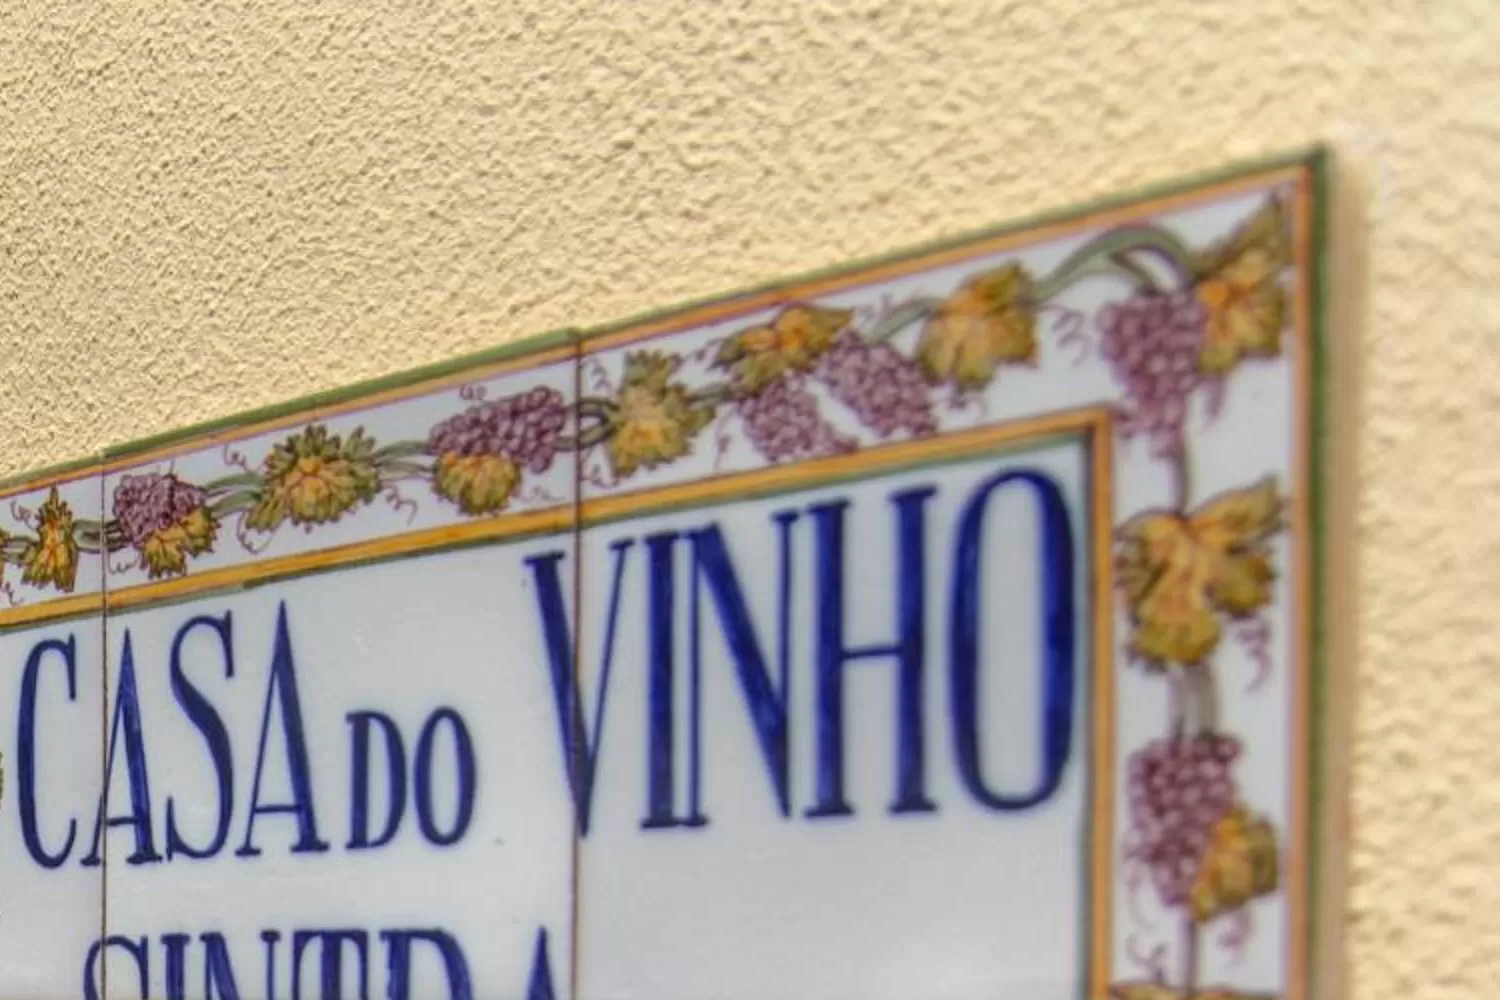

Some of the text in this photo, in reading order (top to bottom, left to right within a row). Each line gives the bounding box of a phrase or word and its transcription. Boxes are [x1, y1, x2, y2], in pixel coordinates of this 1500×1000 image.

[17, 466, 1076, 869] CASA DO VINHO
